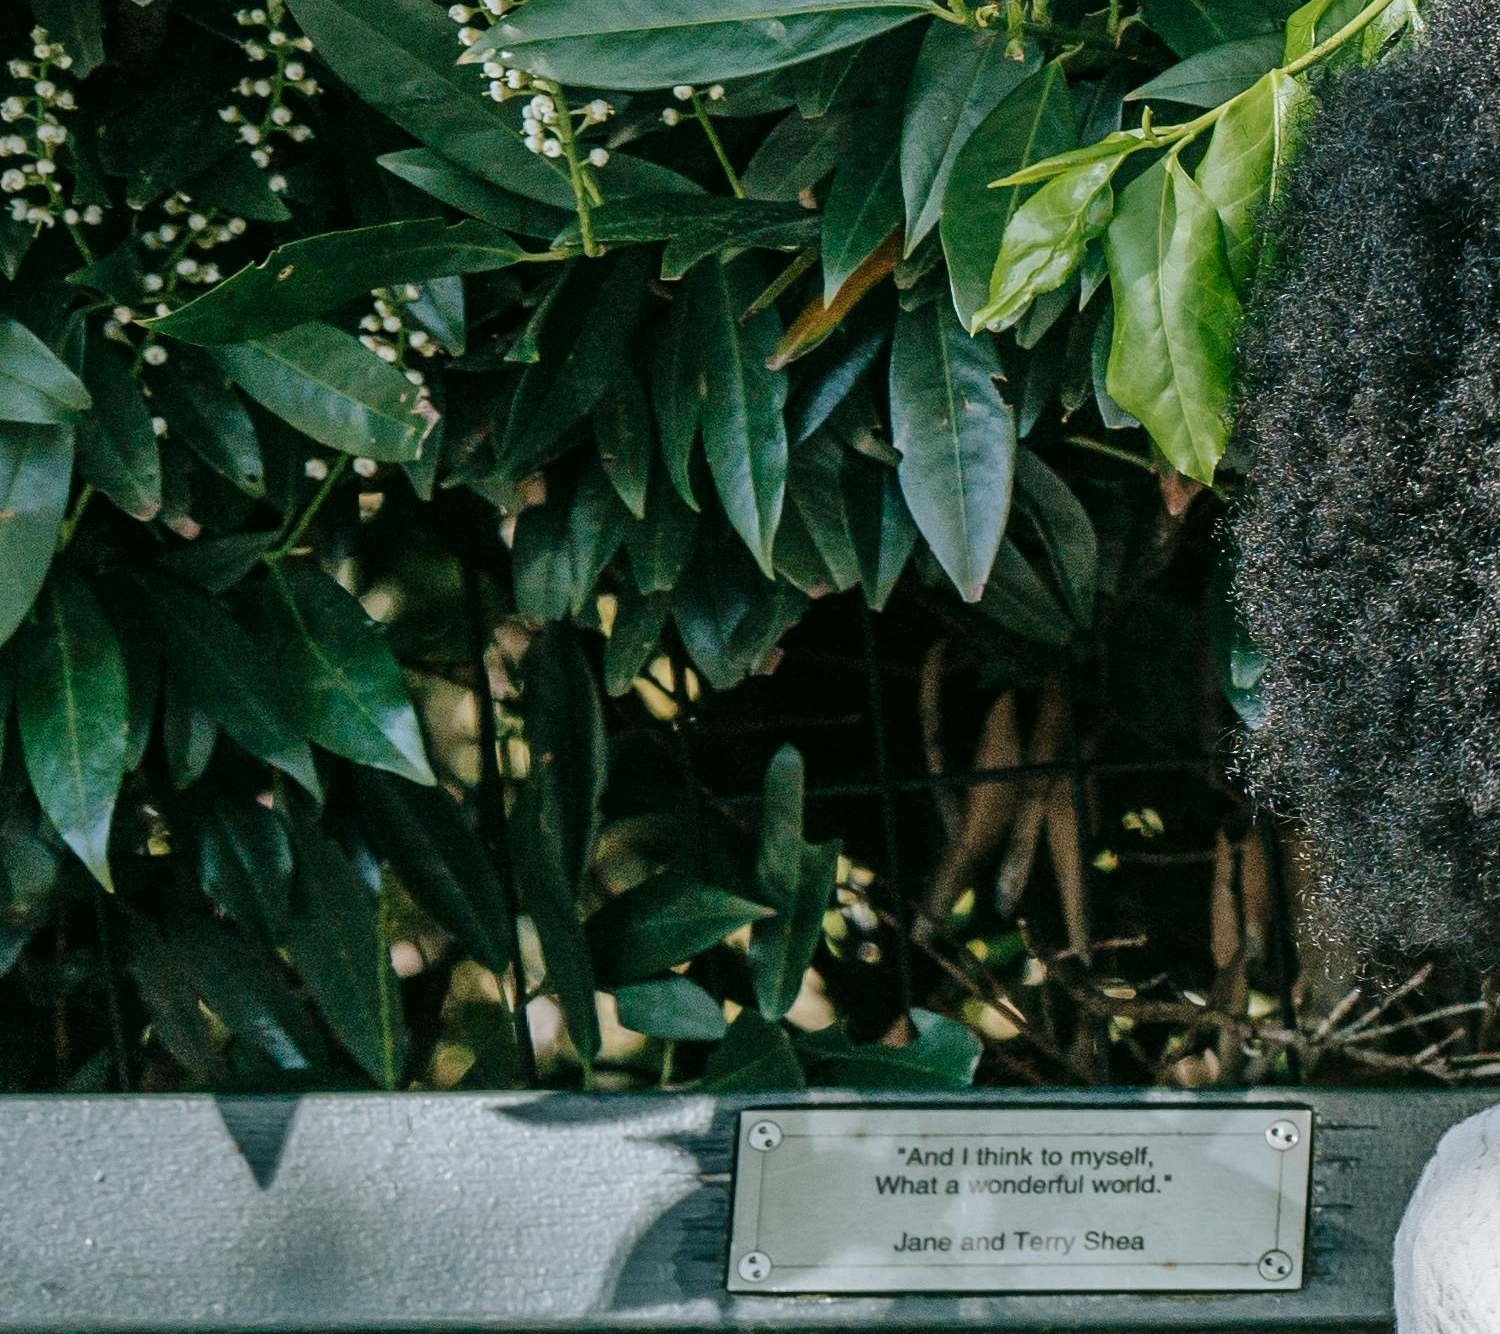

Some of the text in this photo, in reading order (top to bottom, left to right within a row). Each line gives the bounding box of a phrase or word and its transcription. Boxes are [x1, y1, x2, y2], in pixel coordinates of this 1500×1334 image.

[898, 1146, 1155, 1169] "And I think to myself,
[875, 1174, 1172, 1195] What a wonderful world."
[893, 1230, 1145, 1255] Jane and Terry Shea
